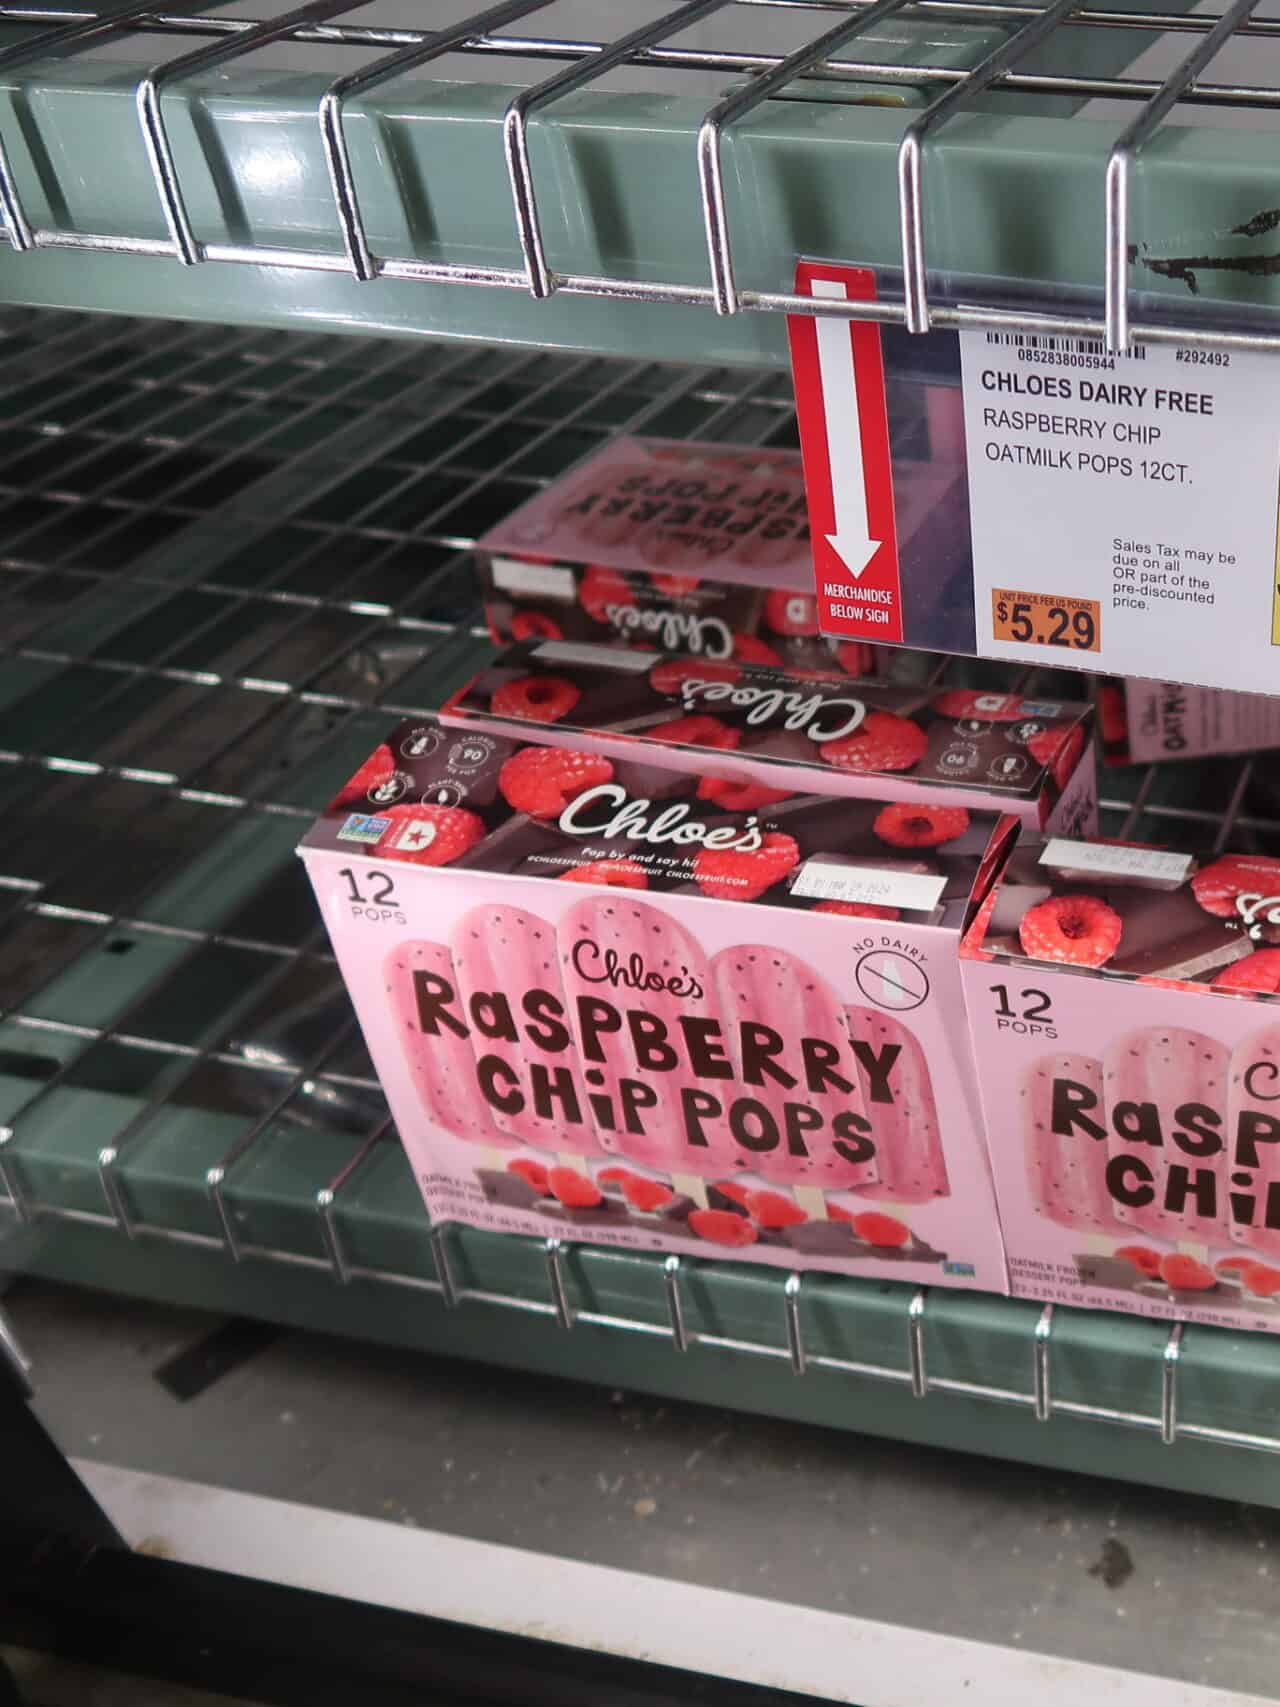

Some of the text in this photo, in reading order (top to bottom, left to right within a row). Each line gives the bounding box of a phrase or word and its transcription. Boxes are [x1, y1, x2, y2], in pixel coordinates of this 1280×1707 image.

[1018, 348, 1115, 370] 0852838005944
[1175, 348, 1230, 366] #292492
[981, 370, 1214, 415] CHLOES DAIRY FREE
[984, 408, 1161, 445] RASPBERRY CHIP
[985, 442, 1193, 484] OATMILK POPS 12CT.
[1113, 538, 1236, 565] Sales Tax may be
[1113, 554, 1180, 572] due on all
[1113, 567, 1210, 590] OR part of the
[824, 583, 893, 605] MERCHANDISE
[1113, 582, 1215, 605] pre-discounted
[1113, 596, 1150, 611] price.
[830, 603, 889, 624] BELOW SIGN
[997, 601, 1095, 649] $5.29
[606, 603, 732, 660] Chloe's
[681, 680, 865, 741] Chloe's
[559, 784, 762, 852] Chloe's
[581, 847, 605, 858] Pop
[609, 849, 625, 861] by
[629, 852, 653, 864] and
[657, 856, 679, 868] say
[339, 868, 400, 907] 12
[351, 906, 407, 925] POPS
[852, 936, 928, 962] NO DAIRY
[571, 939, 703, 998] Chloe's
[989, 983, 1054, 1024] 12
[997, 1019, 1059, 1040] POPS
[684, 1087, 877, 1163] POPS
